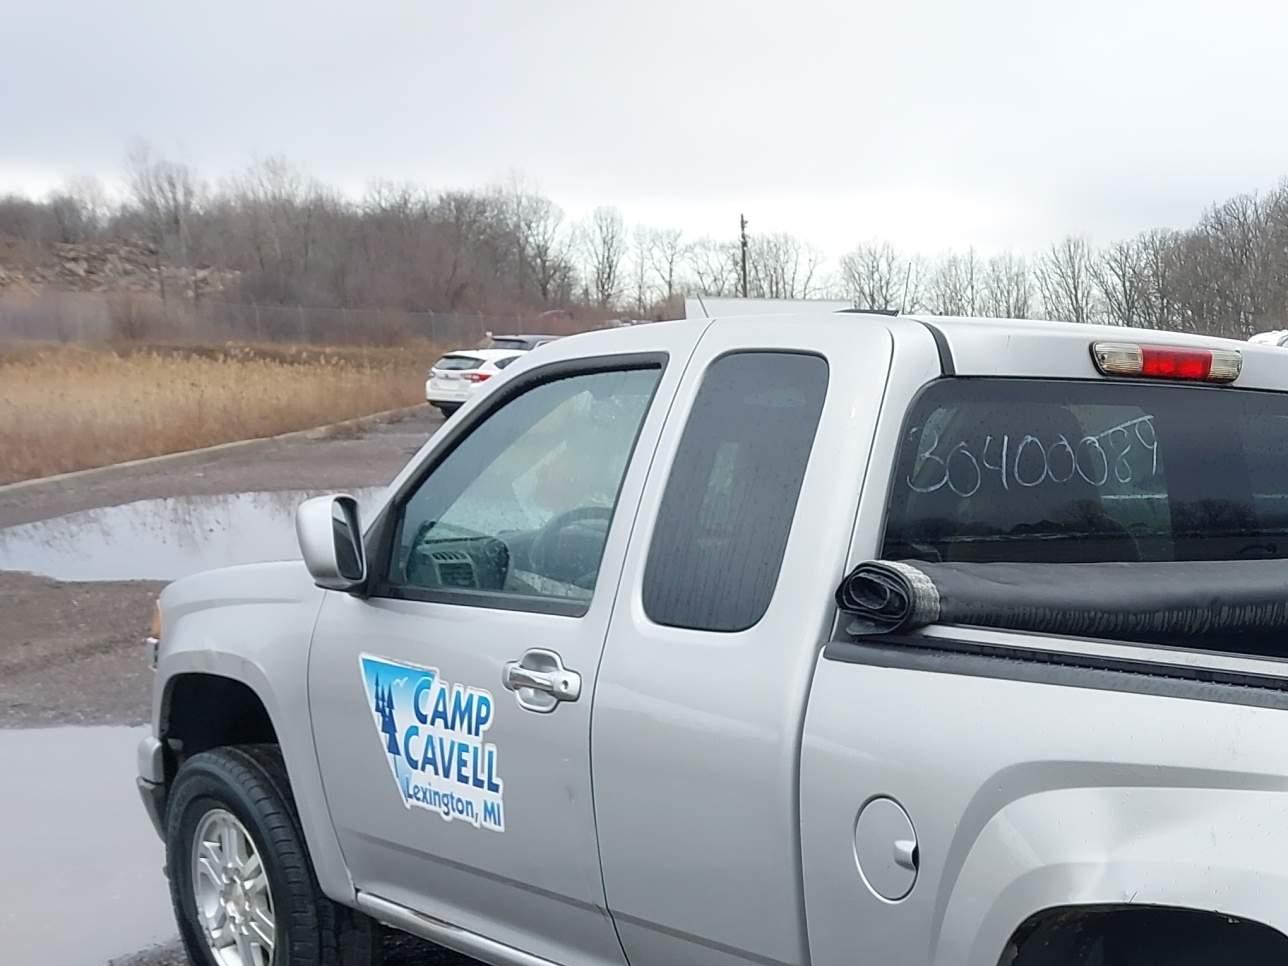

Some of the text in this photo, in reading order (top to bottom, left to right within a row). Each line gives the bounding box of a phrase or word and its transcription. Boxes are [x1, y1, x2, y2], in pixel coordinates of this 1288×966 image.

[413, 676, 491, 737] CAMP
[404, 726, 500, 793] CAVELL
[405, 778, 502, 827] Lexington, MI
